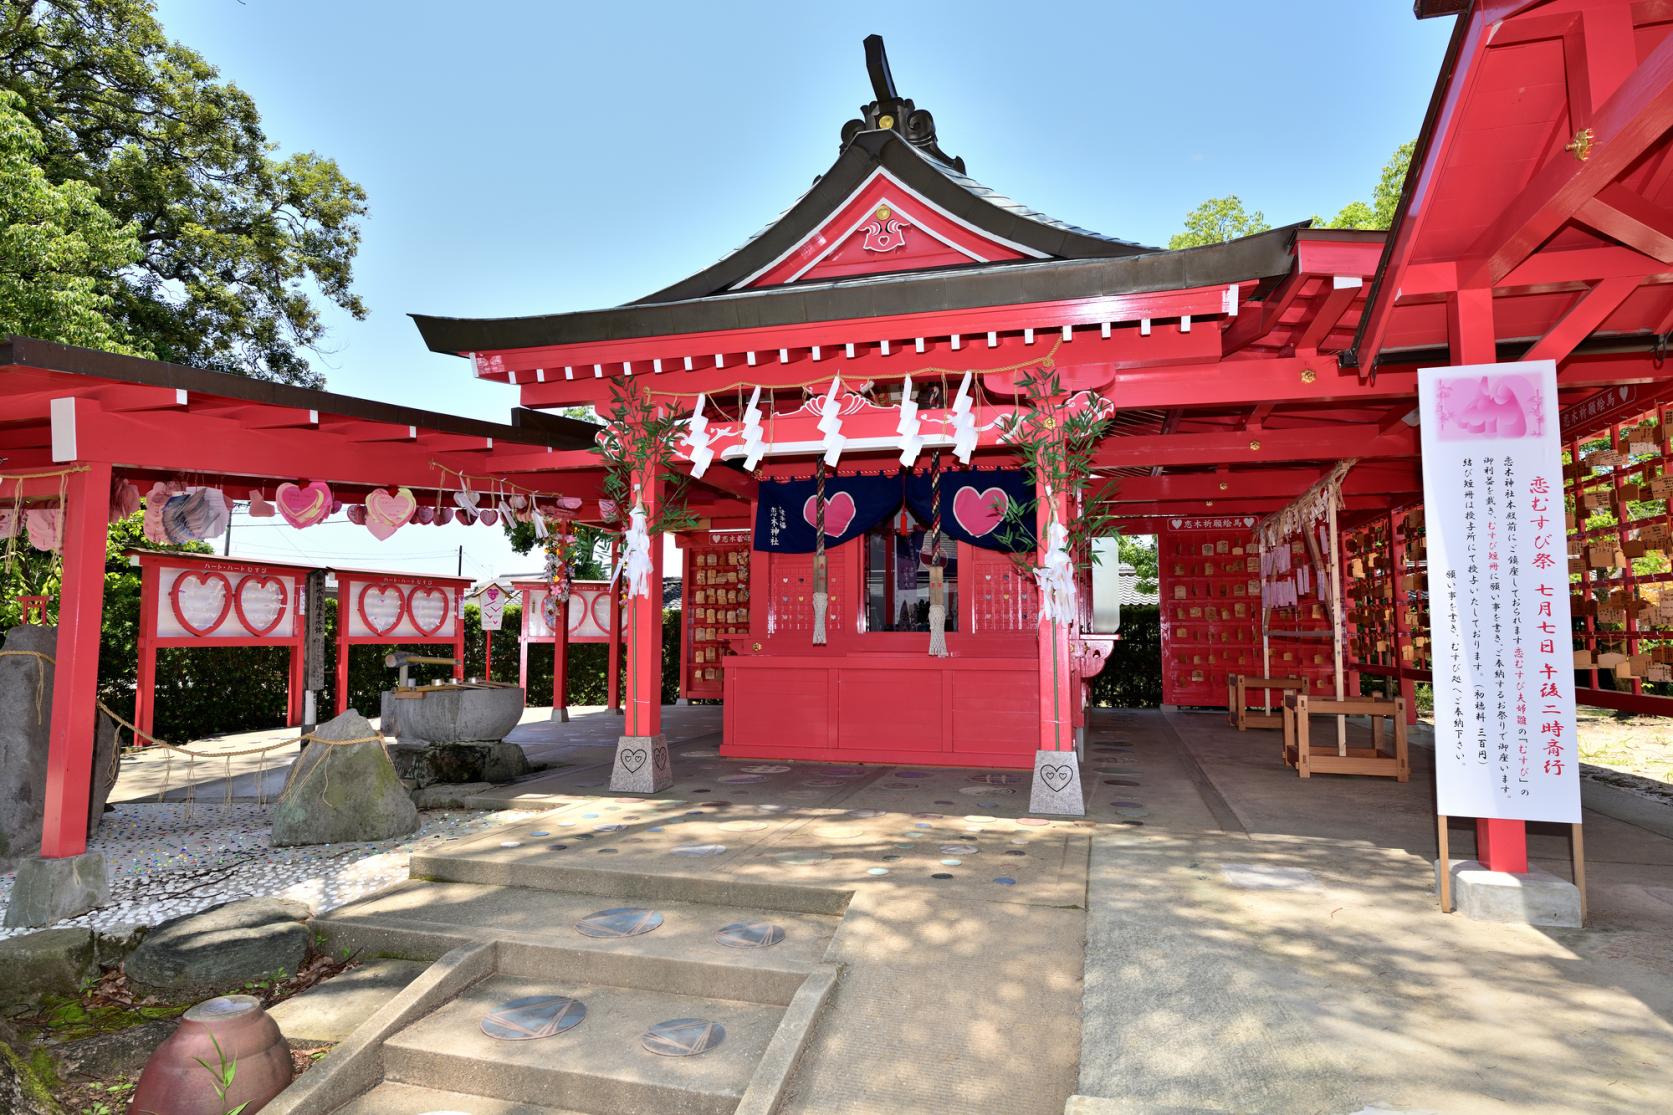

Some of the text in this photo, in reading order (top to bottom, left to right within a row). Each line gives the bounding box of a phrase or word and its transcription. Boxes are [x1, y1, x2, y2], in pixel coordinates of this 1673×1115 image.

[1529, 476, 1564, 776] 恋むすび祭 七月七日 午後二時斎行
